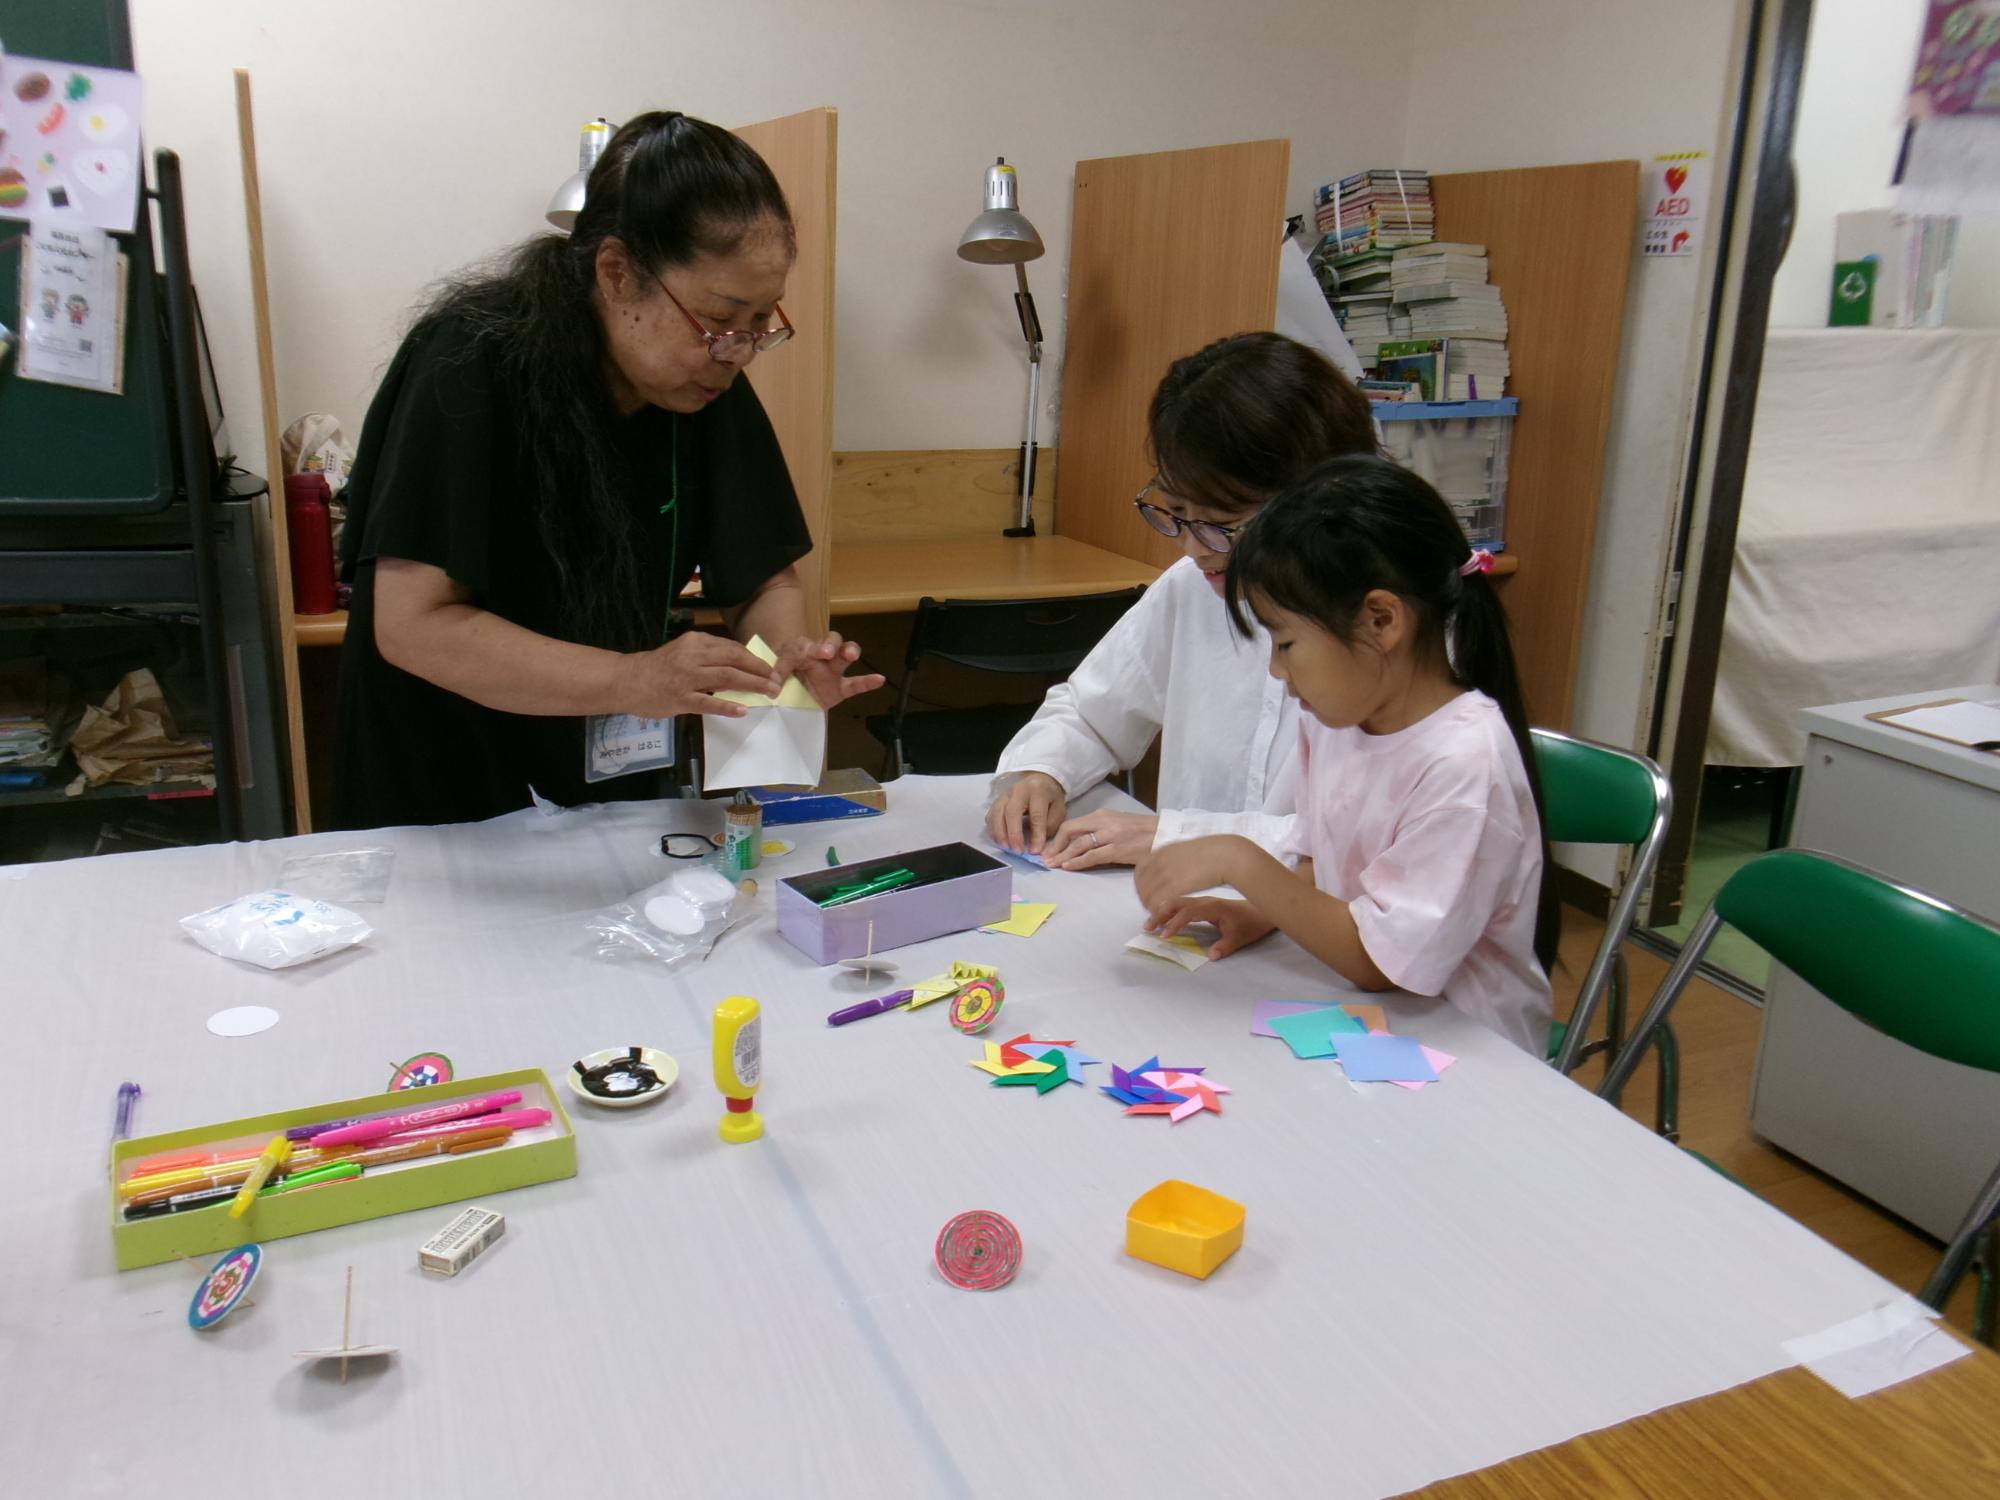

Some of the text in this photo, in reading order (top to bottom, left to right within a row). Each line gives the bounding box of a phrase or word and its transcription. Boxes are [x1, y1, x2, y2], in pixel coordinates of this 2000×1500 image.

[1655, 198, 1690, 217] AED
[638, 740, 661, 751] はるこ
